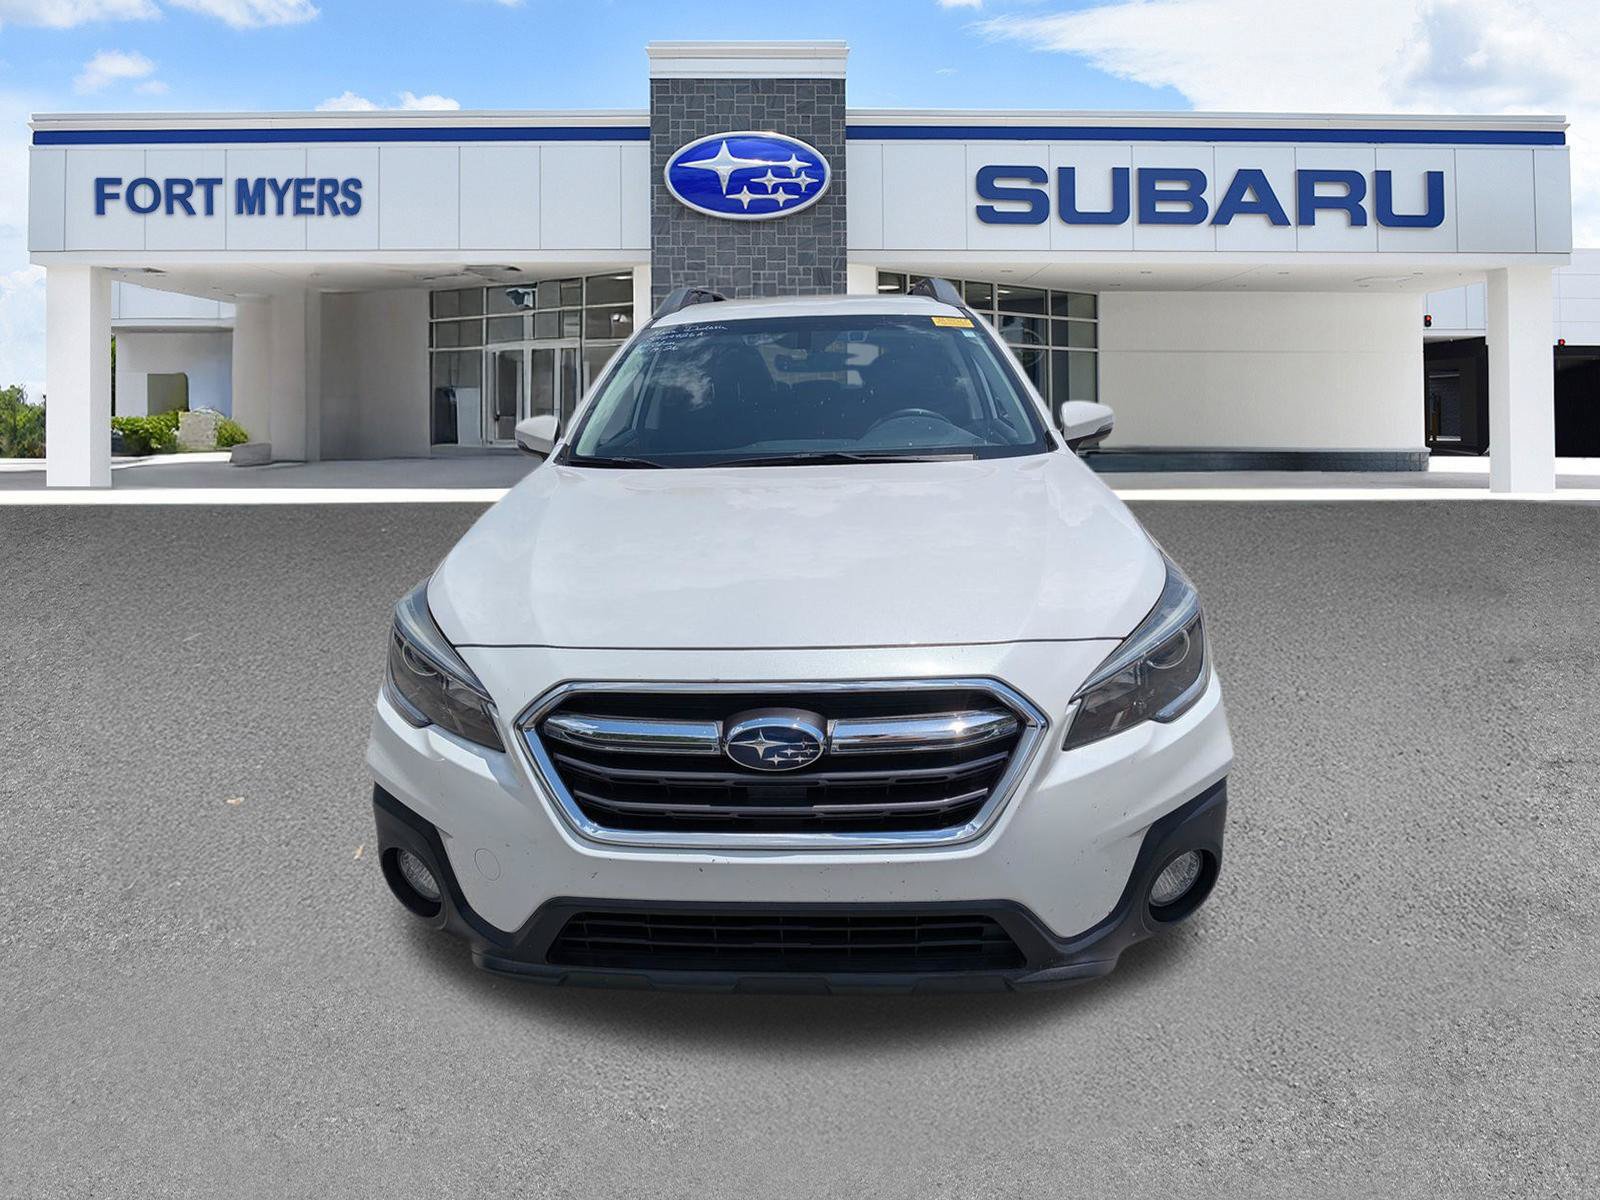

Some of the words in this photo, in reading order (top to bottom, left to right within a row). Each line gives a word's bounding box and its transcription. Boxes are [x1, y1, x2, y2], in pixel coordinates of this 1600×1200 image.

[94, 177, 223, 215] FORT
[235, 177, 362, 216] MYERS
[976, 165, 1445, 228] SUBARU
